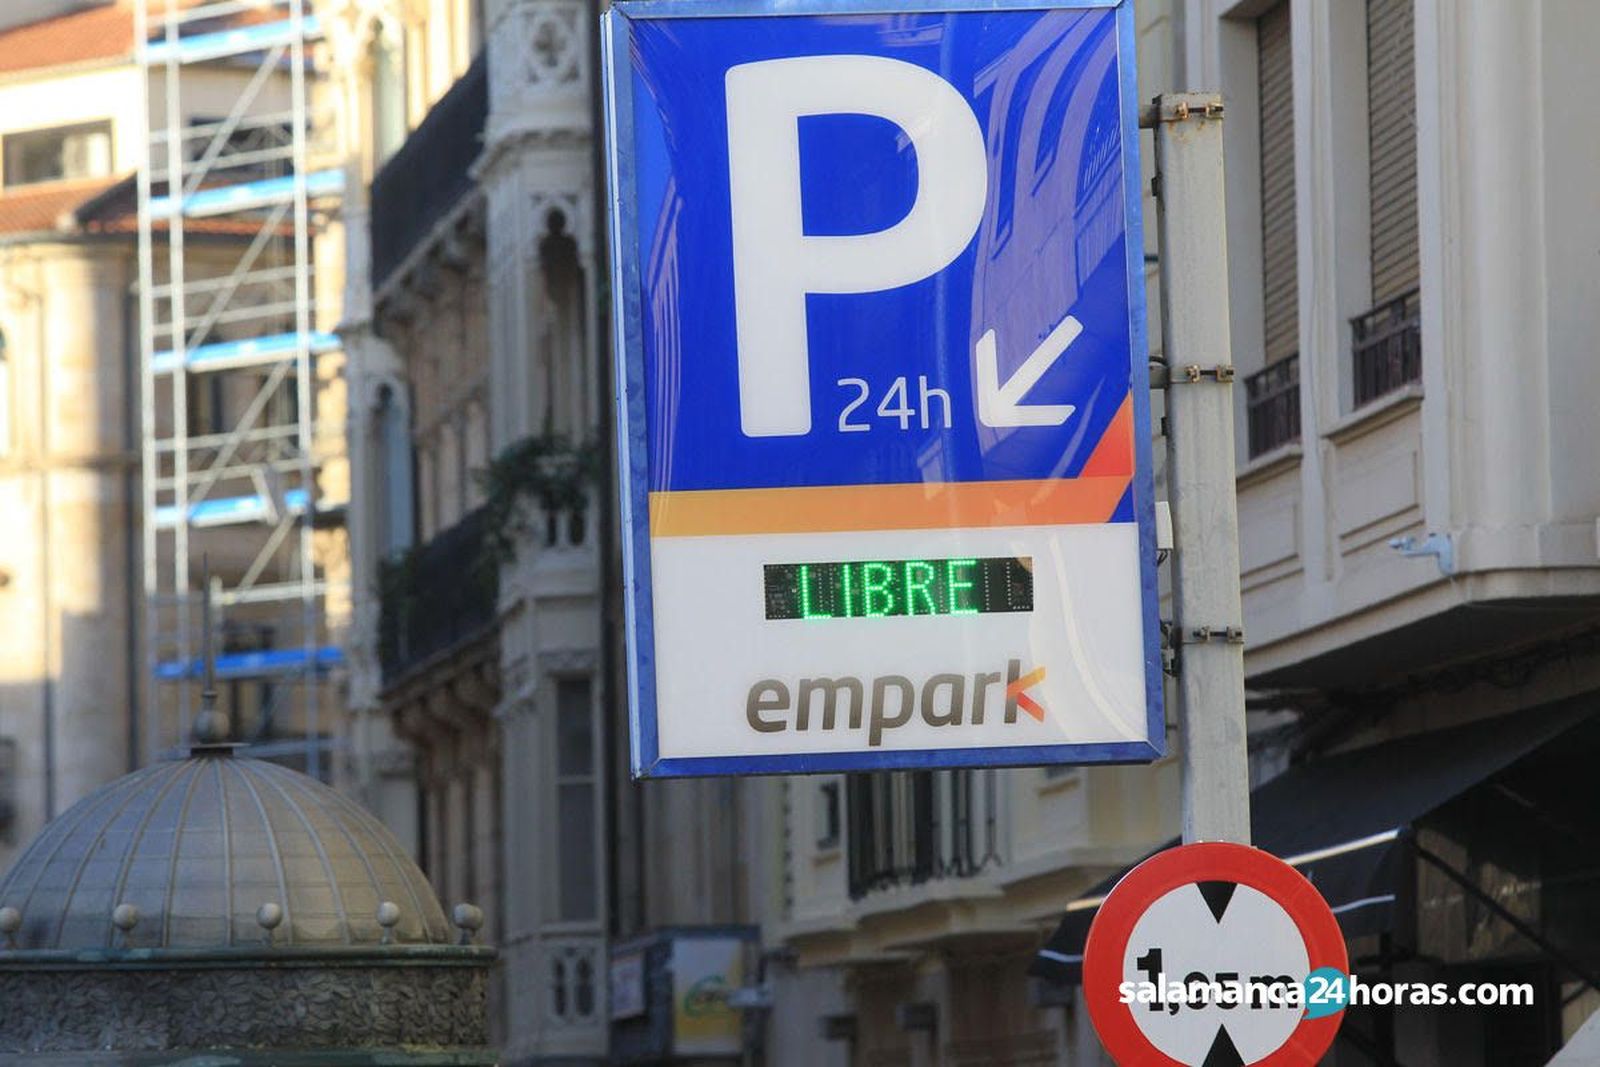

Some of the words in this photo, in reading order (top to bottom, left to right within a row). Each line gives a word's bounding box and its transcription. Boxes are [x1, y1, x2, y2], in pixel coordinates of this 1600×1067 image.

[724, 54, 988, 438] P
[837, 375, 952, 432] 24h
[798, 558, 980, 619] LIBRE
[746, 659, 1046, 747] empark
